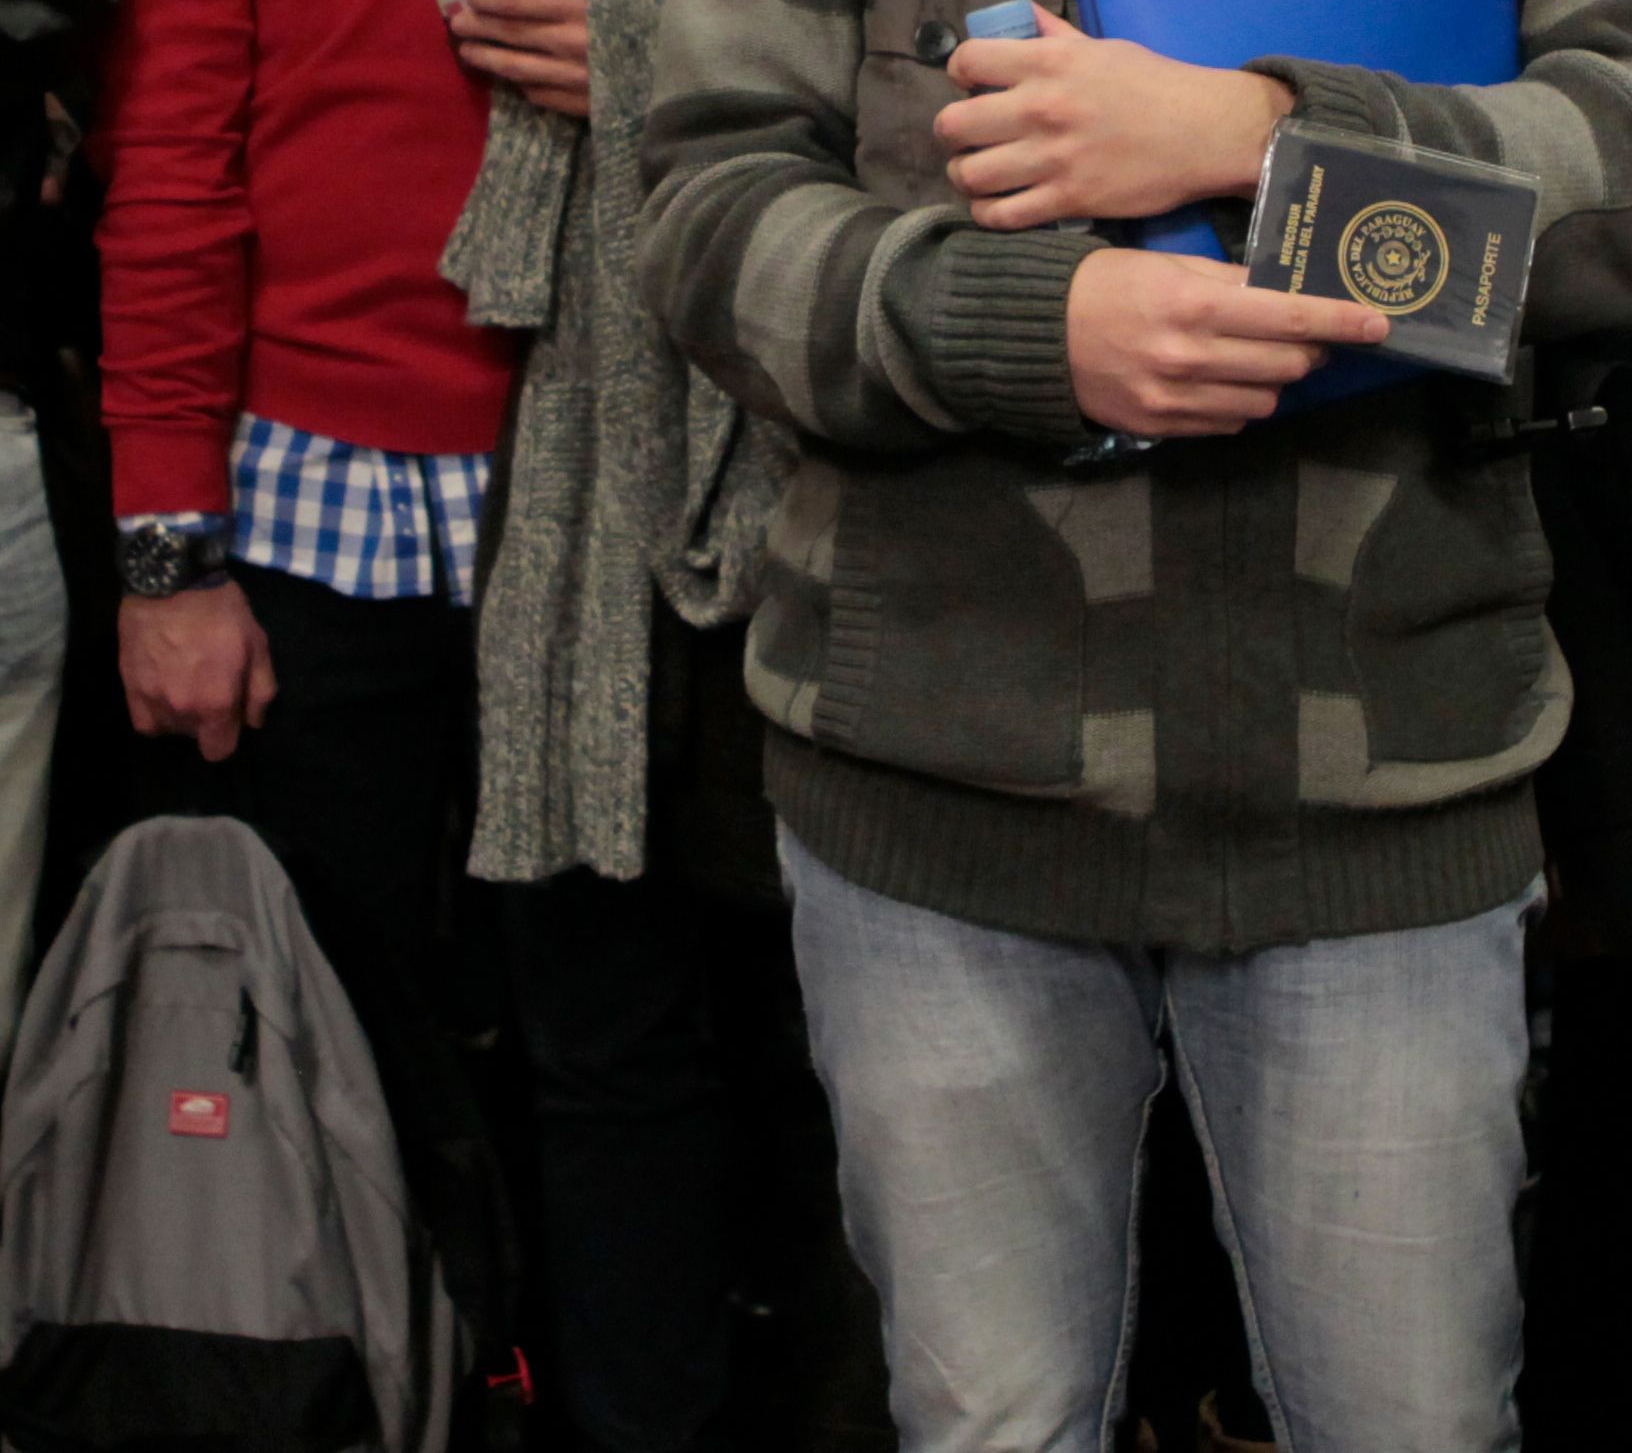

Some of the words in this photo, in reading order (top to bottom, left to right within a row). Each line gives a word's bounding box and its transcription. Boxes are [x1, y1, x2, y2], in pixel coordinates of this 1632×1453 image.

[1303, 164, 1326, 224] PARAGUAY
[1279, 203, 1303, 266] MERCOSUR
[1298, 226, 1314, 248] DEL
[1360, 214, 1427, 237] PARAGUAY
[1351, 236, 1365, 262] DEL
[1288, 249, 1309, 295] PUBLICA
[1352, 261, 1415, 302] REPUBLICA
[1471, 232, 1502, 326] PASAPORTE
